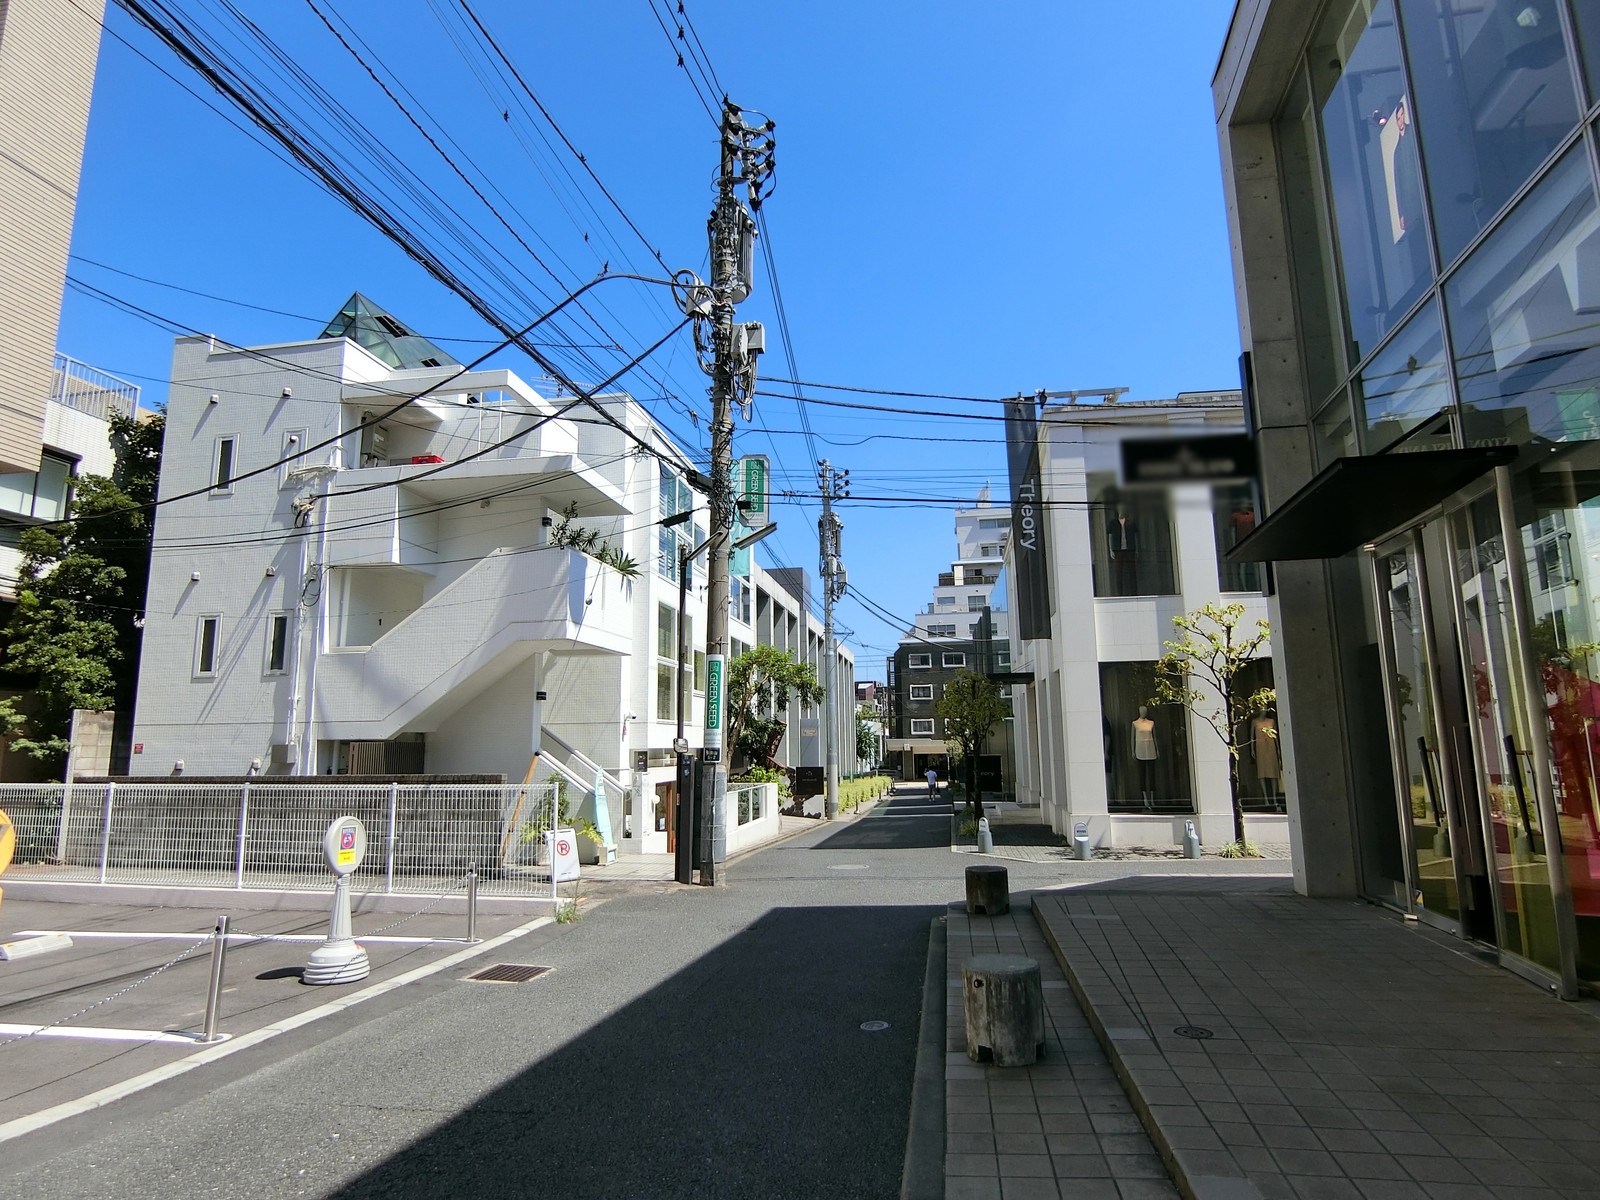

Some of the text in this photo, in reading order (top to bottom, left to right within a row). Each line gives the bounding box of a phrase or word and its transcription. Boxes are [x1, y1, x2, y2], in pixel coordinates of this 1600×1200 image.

[751, 470, 759, 493] GREEN
[1019, 478, 1037, 551] Theory
[709, 673, 719, 702] GREEN
[708, 704, 717, 727] SEED
